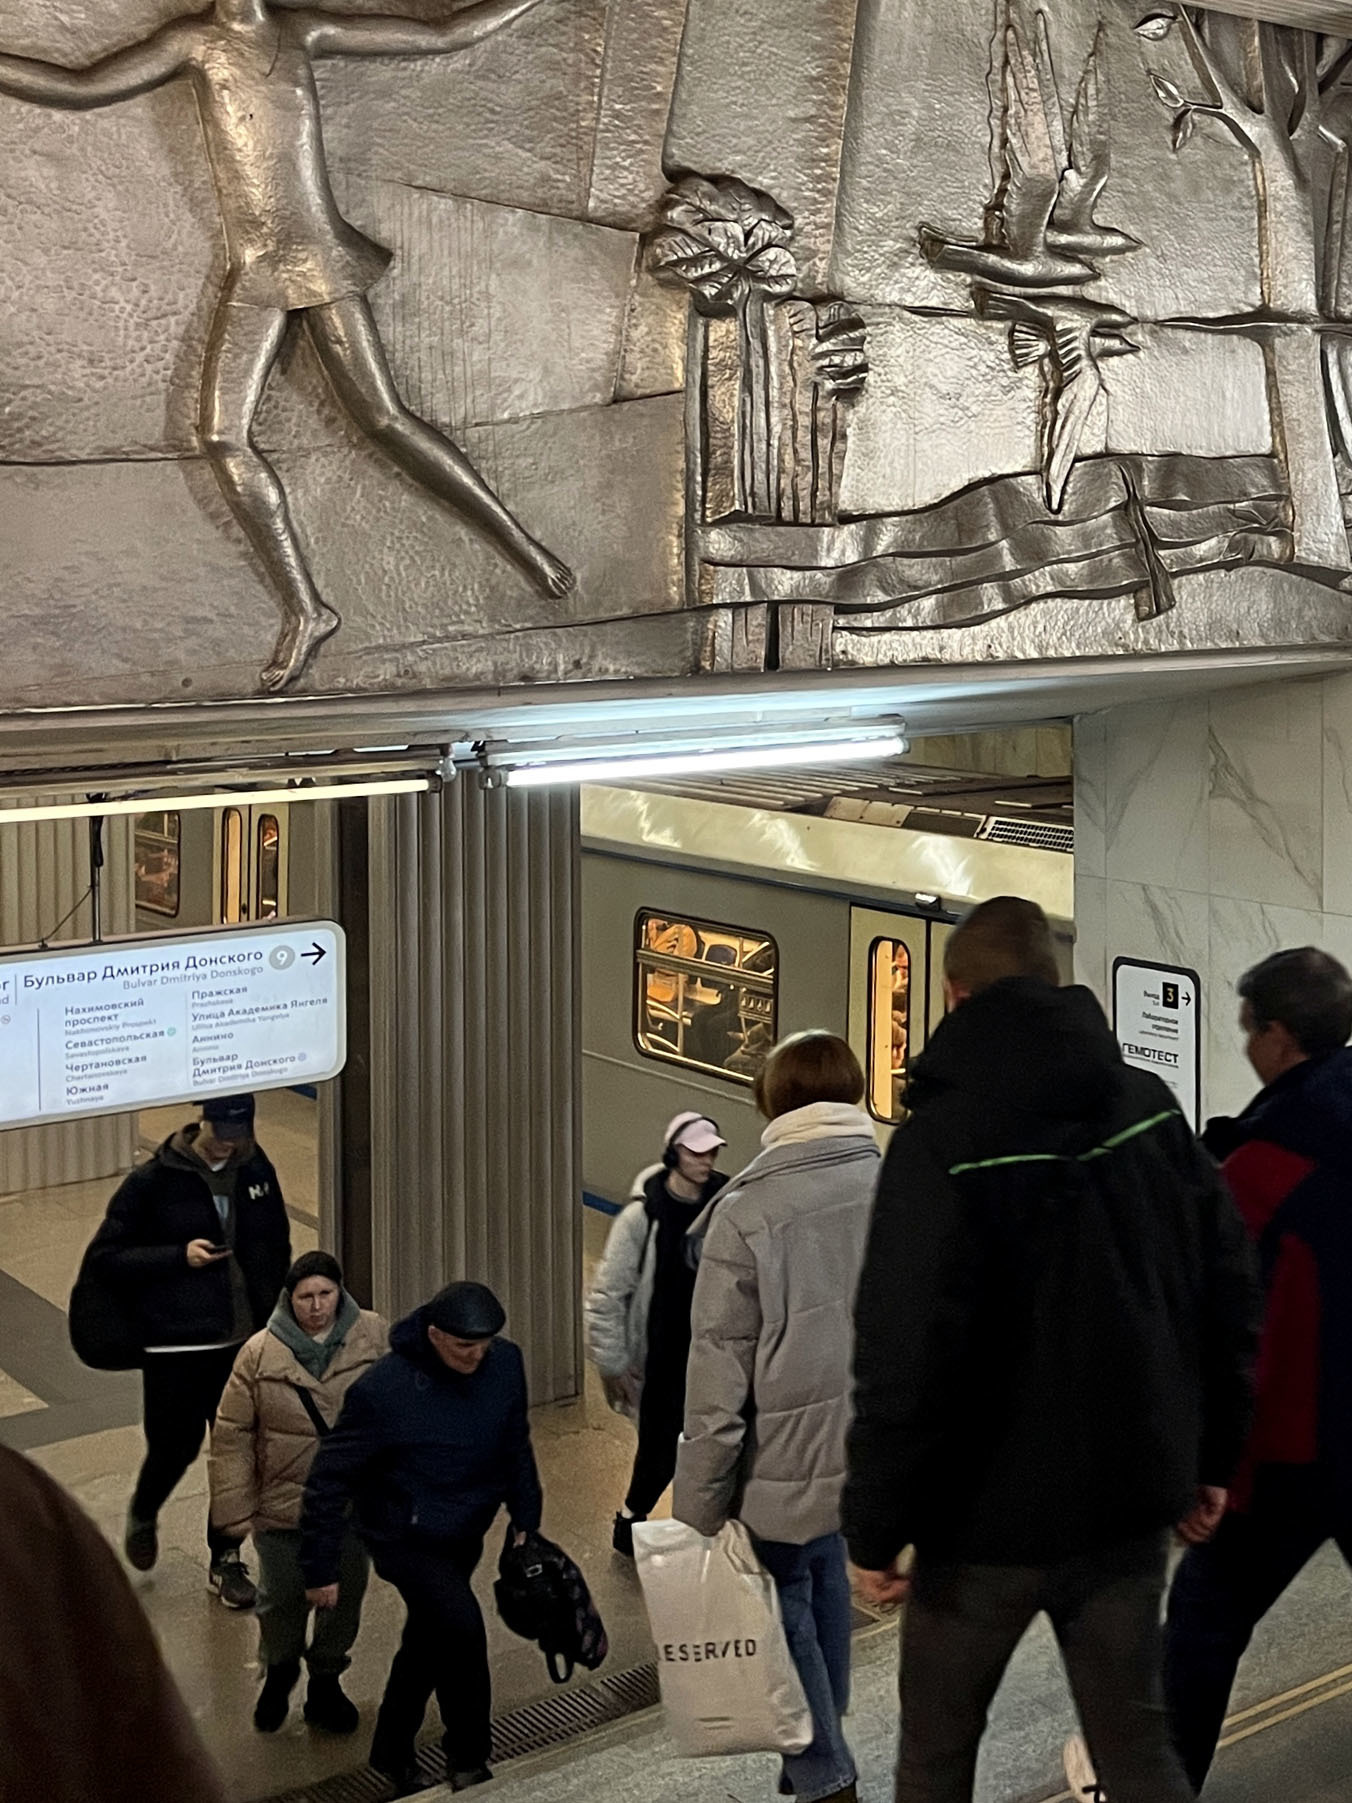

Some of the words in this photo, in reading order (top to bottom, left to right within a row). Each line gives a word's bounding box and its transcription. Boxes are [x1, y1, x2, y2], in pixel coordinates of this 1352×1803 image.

[24, 970, 97, 990] Бульвар
[102, 961, 180, 980] Дмитрия
[185, 951, 263, 971] Донского
[276, 950, 288, 966] 9
[123, 978, 157, 990] Bulvar
[161, 971, 207, 986] Dmitriya
[210, 966, 263, 980] Donskogo
[192, 986, 248, 1000] Пражская
[65, 998, 144, 1016] Нахимовский
[192, 1010, 225, 1022] Улица
[228, 1002, 288, 1017] Академика
[290, 997, 328, 1009] Янгеля
[65, 1013, 119, 1028] проспект
[65, 1030, 165, 1050] Севастопольская
[192, 1032, 234, 1044] Аннино
[65, 1055, 147, 1073] Чертановская
[192, 1053, 239, 1067] Бульвар
[192, 1063, 242, 1078] Дмитрия
[245, 1055, 296, 1070] Донского
[66, 1083, 109, 1096] Южная
[663, 1638, 757, 1662] ESERVED
